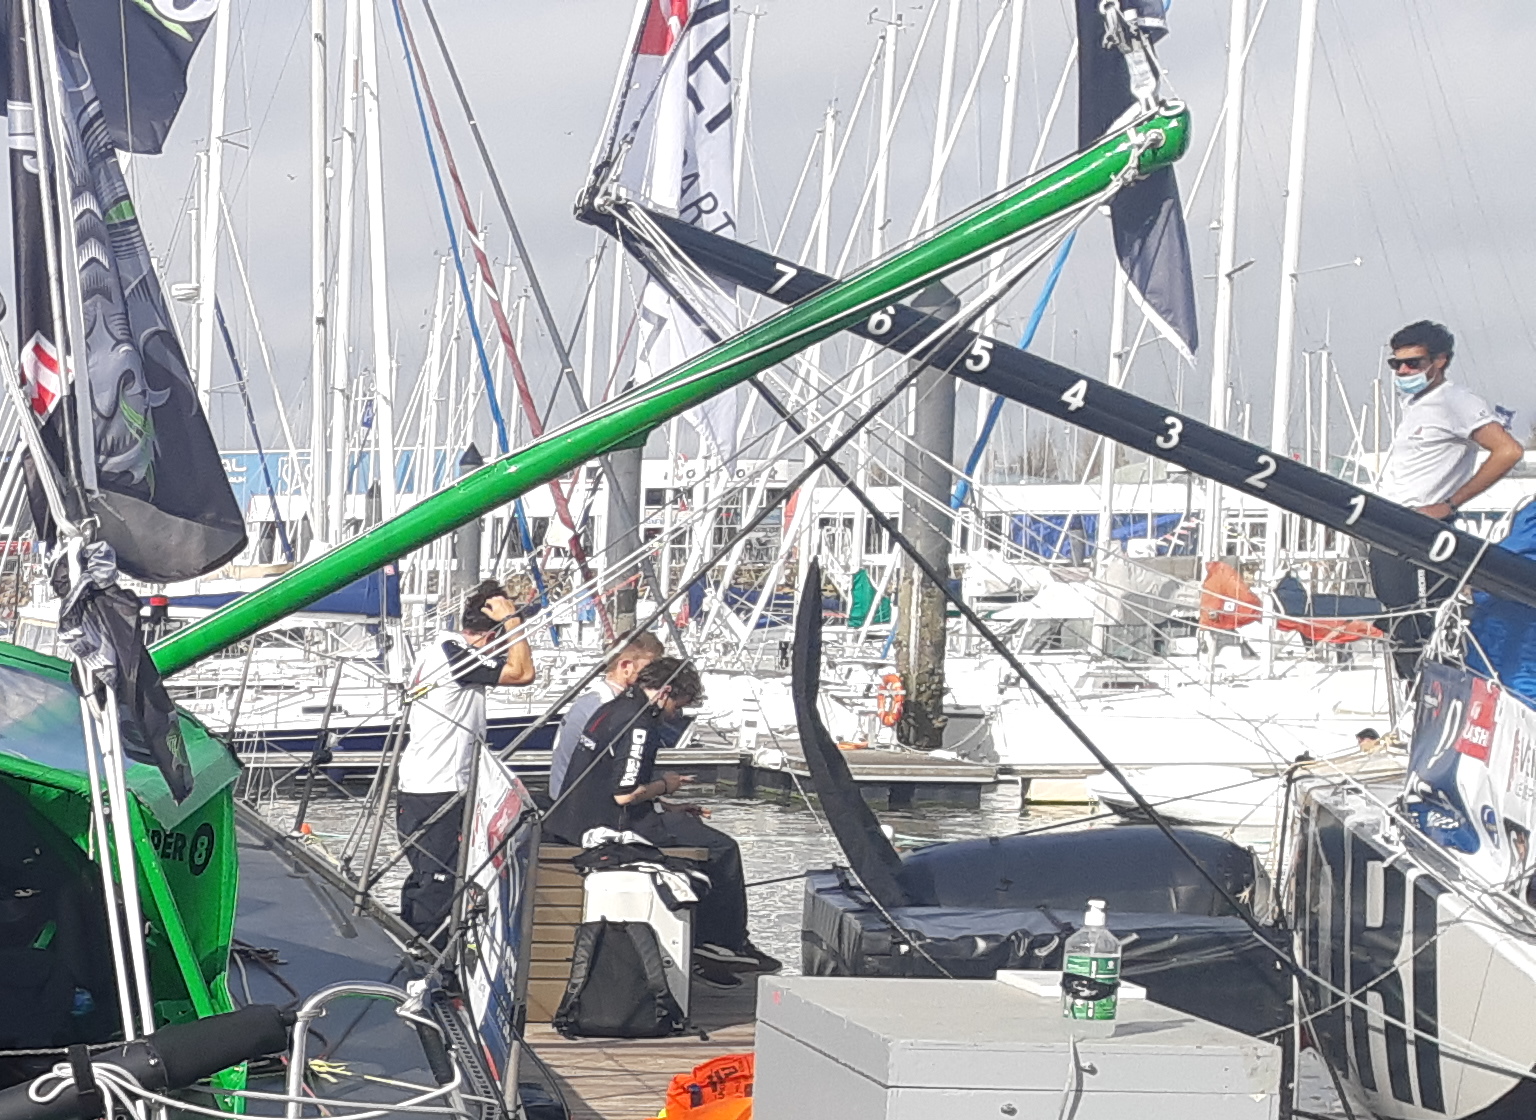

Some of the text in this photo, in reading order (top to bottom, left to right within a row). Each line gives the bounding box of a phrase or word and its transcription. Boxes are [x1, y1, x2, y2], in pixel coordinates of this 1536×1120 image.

[774, 262, 798, 294] 7
[868, 305, 896, 336] 6
[964, 337, 993, 371] 5
[1060, 379, 1088, 412] 4
[1156, 416, 1184, 450] 3
[1244, 455, 1278, 488] 2
[1345, 494, 1367, 526] 1
